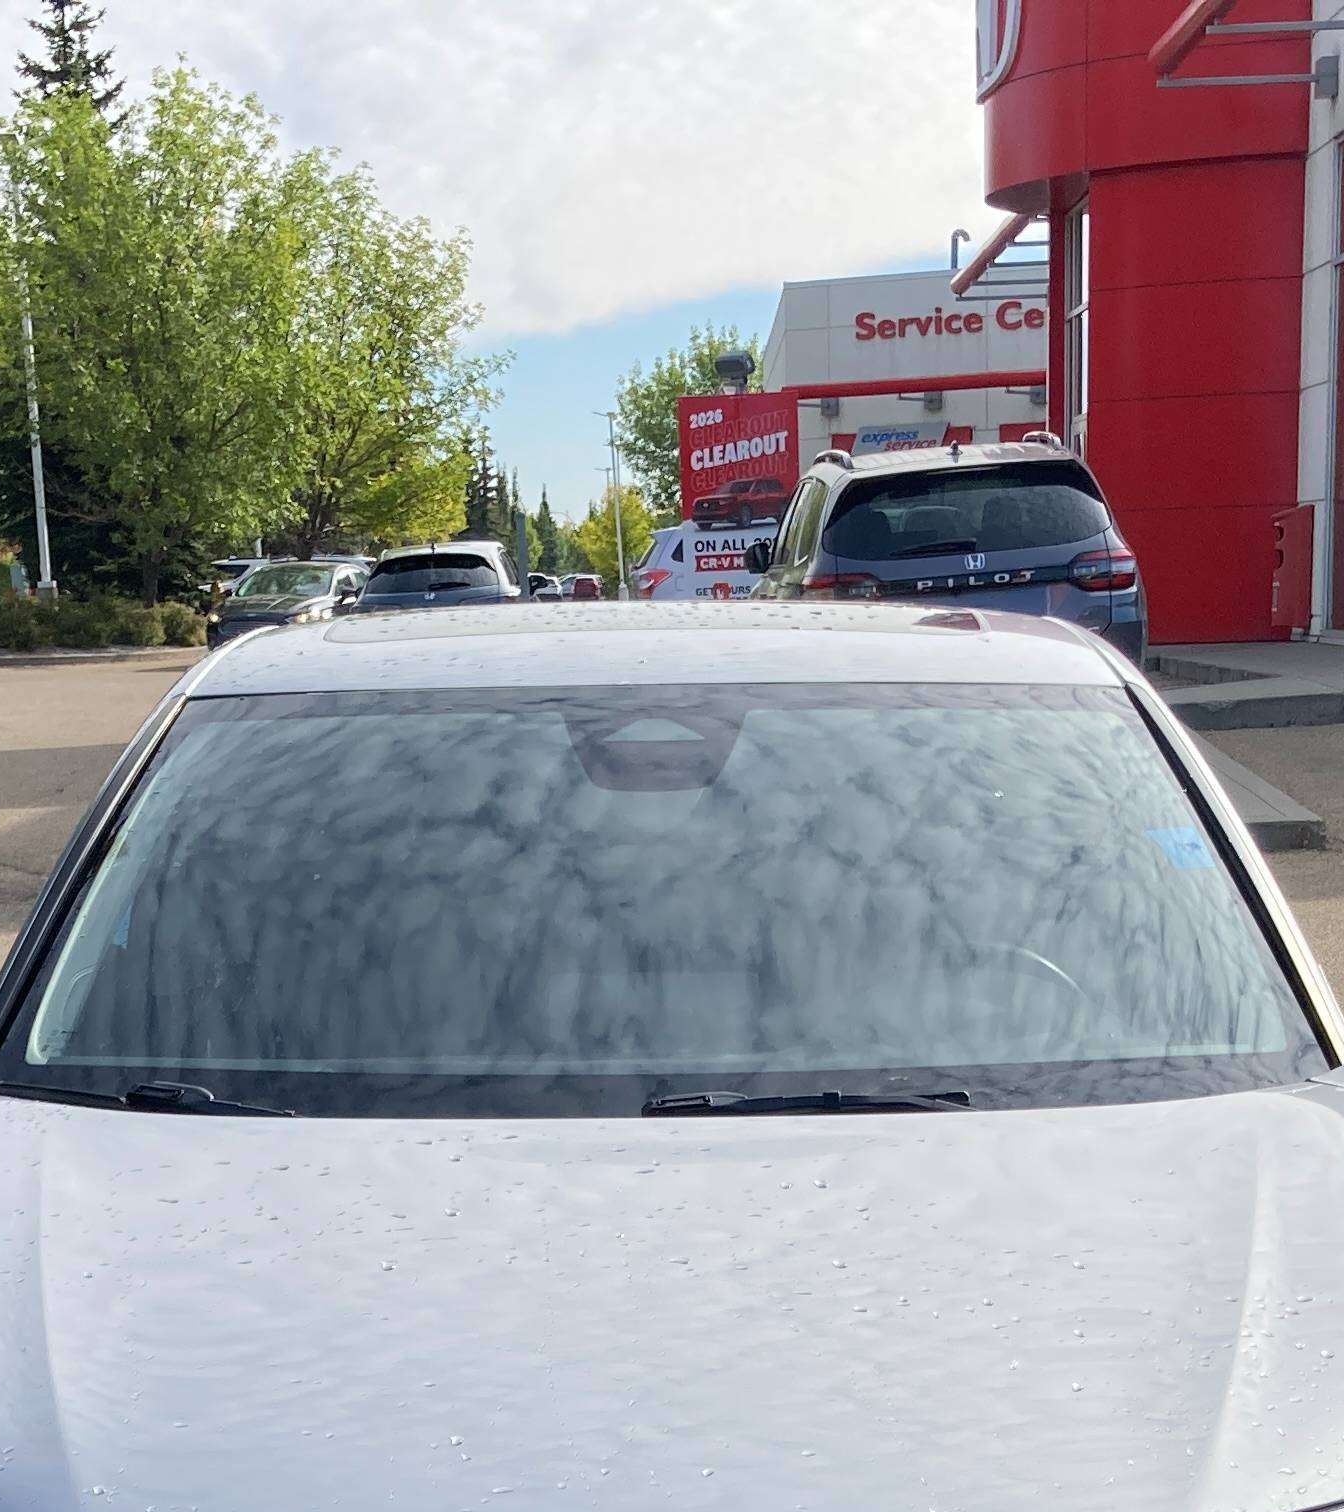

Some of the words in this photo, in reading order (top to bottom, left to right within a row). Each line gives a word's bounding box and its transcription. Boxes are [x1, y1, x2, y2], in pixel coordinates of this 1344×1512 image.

[855, 307, 984, 341] Service
[995, 300, 1045, 331] Ce
[689, 408, 723, 430] 2026
[861, 429, 920, 446] express
[690, 430, 789, 471] CLEAROUT
[695, 539, 717, 553] ON
[721, 537, 747, 552] ALL
[699, 556, 731, 570] CR-V
[729, 585, 751, 595] URS
[917, 570, 1036, 591] PILOT
